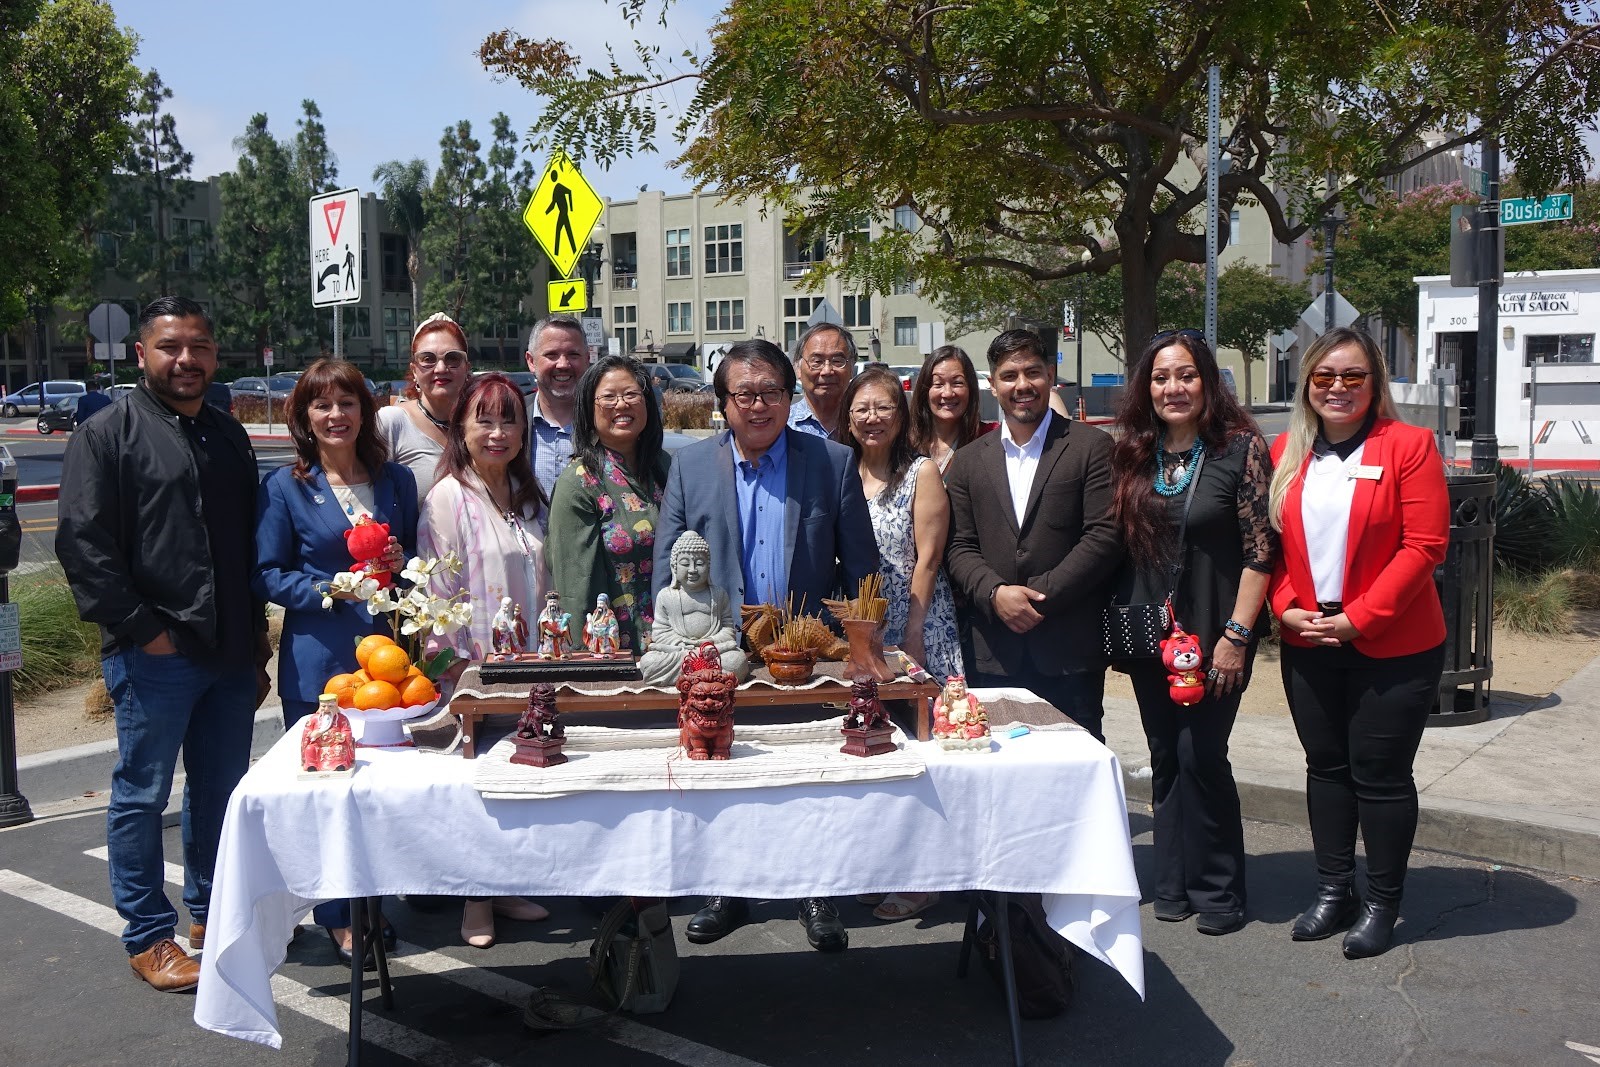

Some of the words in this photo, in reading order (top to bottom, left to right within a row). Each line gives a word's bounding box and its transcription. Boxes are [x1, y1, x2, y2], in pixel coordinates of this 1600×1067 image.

[1505, 200, 1542, 220] Bush
[1552, 197, 1561, 207] ST
[1544, 207, 1560, 218] 300
[315, 248, 330, 263] HERE
[333, 280, 340, 297] TO
[1503, 292, 1526, 301] Casa
[1529, 291, 1567, 300] Blanca
[1529, 301, 1569, 312] SALON
[1450, 317, 1467, 325] 300
